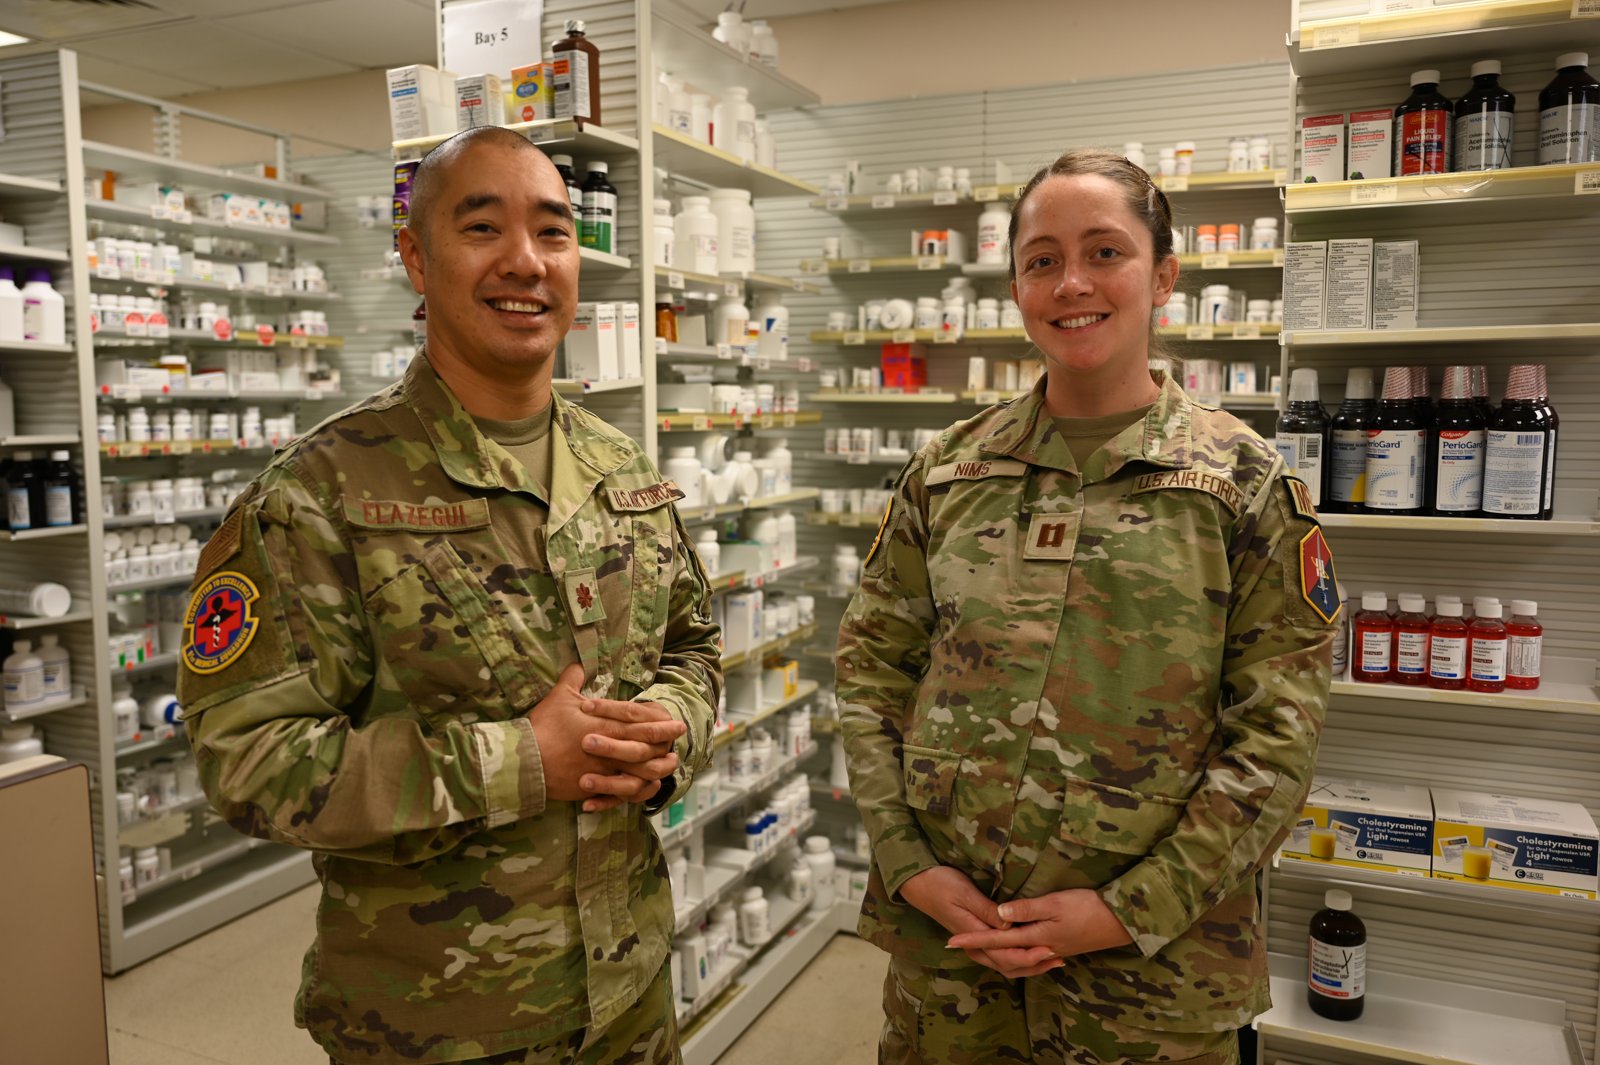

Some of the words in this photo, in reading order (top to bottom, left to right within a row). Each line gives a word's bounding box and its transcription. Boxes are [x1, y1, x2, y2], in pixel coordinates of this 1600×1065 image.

[475, 31, 496, 46] Bay
[501, 27, 509, 41] 5
[1414, 127, 1436, 135] LIQUID
[1443, 441, 1483, 449] PerioGard
[954, 461, 992, 477] NIMS
[612, 490, 632, 508] U.S.
[640, 482, 677, 507] FORCE
[1138, 473, 1165, 489] U.S.
[1167, 471, 1197, 487] AIR
[1200, 473, 1242, 512] FORCE
[362, 502, 467, 527] ELAZEGUI
[1357, 817, 1428, 832] Cholestyramine
[1367, 832, 1389, 841] Light
[1516, 836, 1593, 851] Cholestyramine
[1526, 851, 1550, 860] Light
